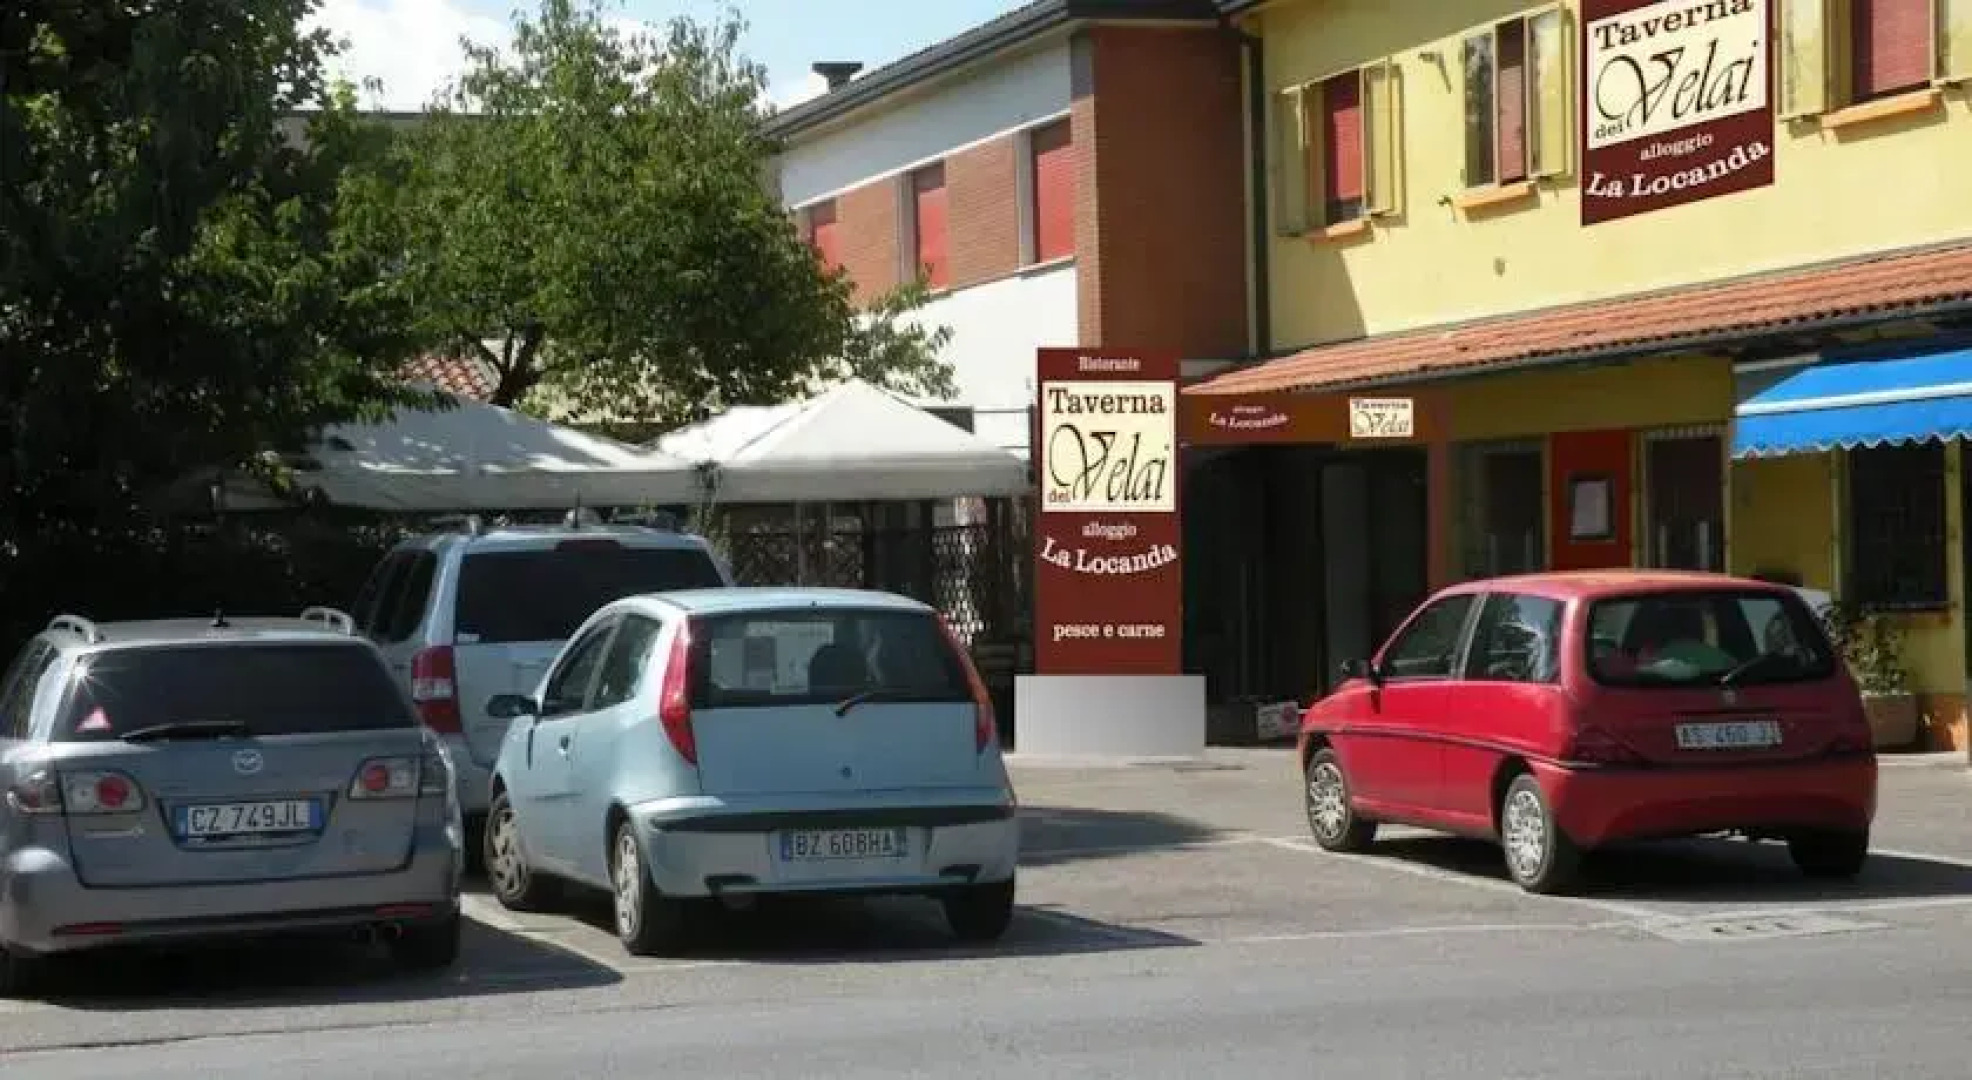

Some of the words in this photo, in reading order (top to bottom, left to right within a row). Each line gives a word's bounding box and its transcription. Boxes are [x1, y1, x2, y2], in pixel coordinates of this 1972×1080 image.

[1595, 0, 1756, 49] Taverna
[1596, 38, 1759, 125] Velai
[1640, 133, 1714, 161] alloggio
[1586, 173, 1625, 198] La
[1631, 141, 1769, 196] Locanda
[1048, 387, 1166, 414] Taverna
[1049, 422, 1170, 502] Velai
[1082, 521, 1137, 541] alloggio
[1040, 536, 1071, 569] La
[1074, 544, 1177, 574] Locanda
[1053, 623, 1100, 642] pesce
[1103, 624, 1114, 638] e
[1117, 623, 1166, 638] carne
[192, 807, 221, 832] CZ
[795, 834, 823, 856] BZ
